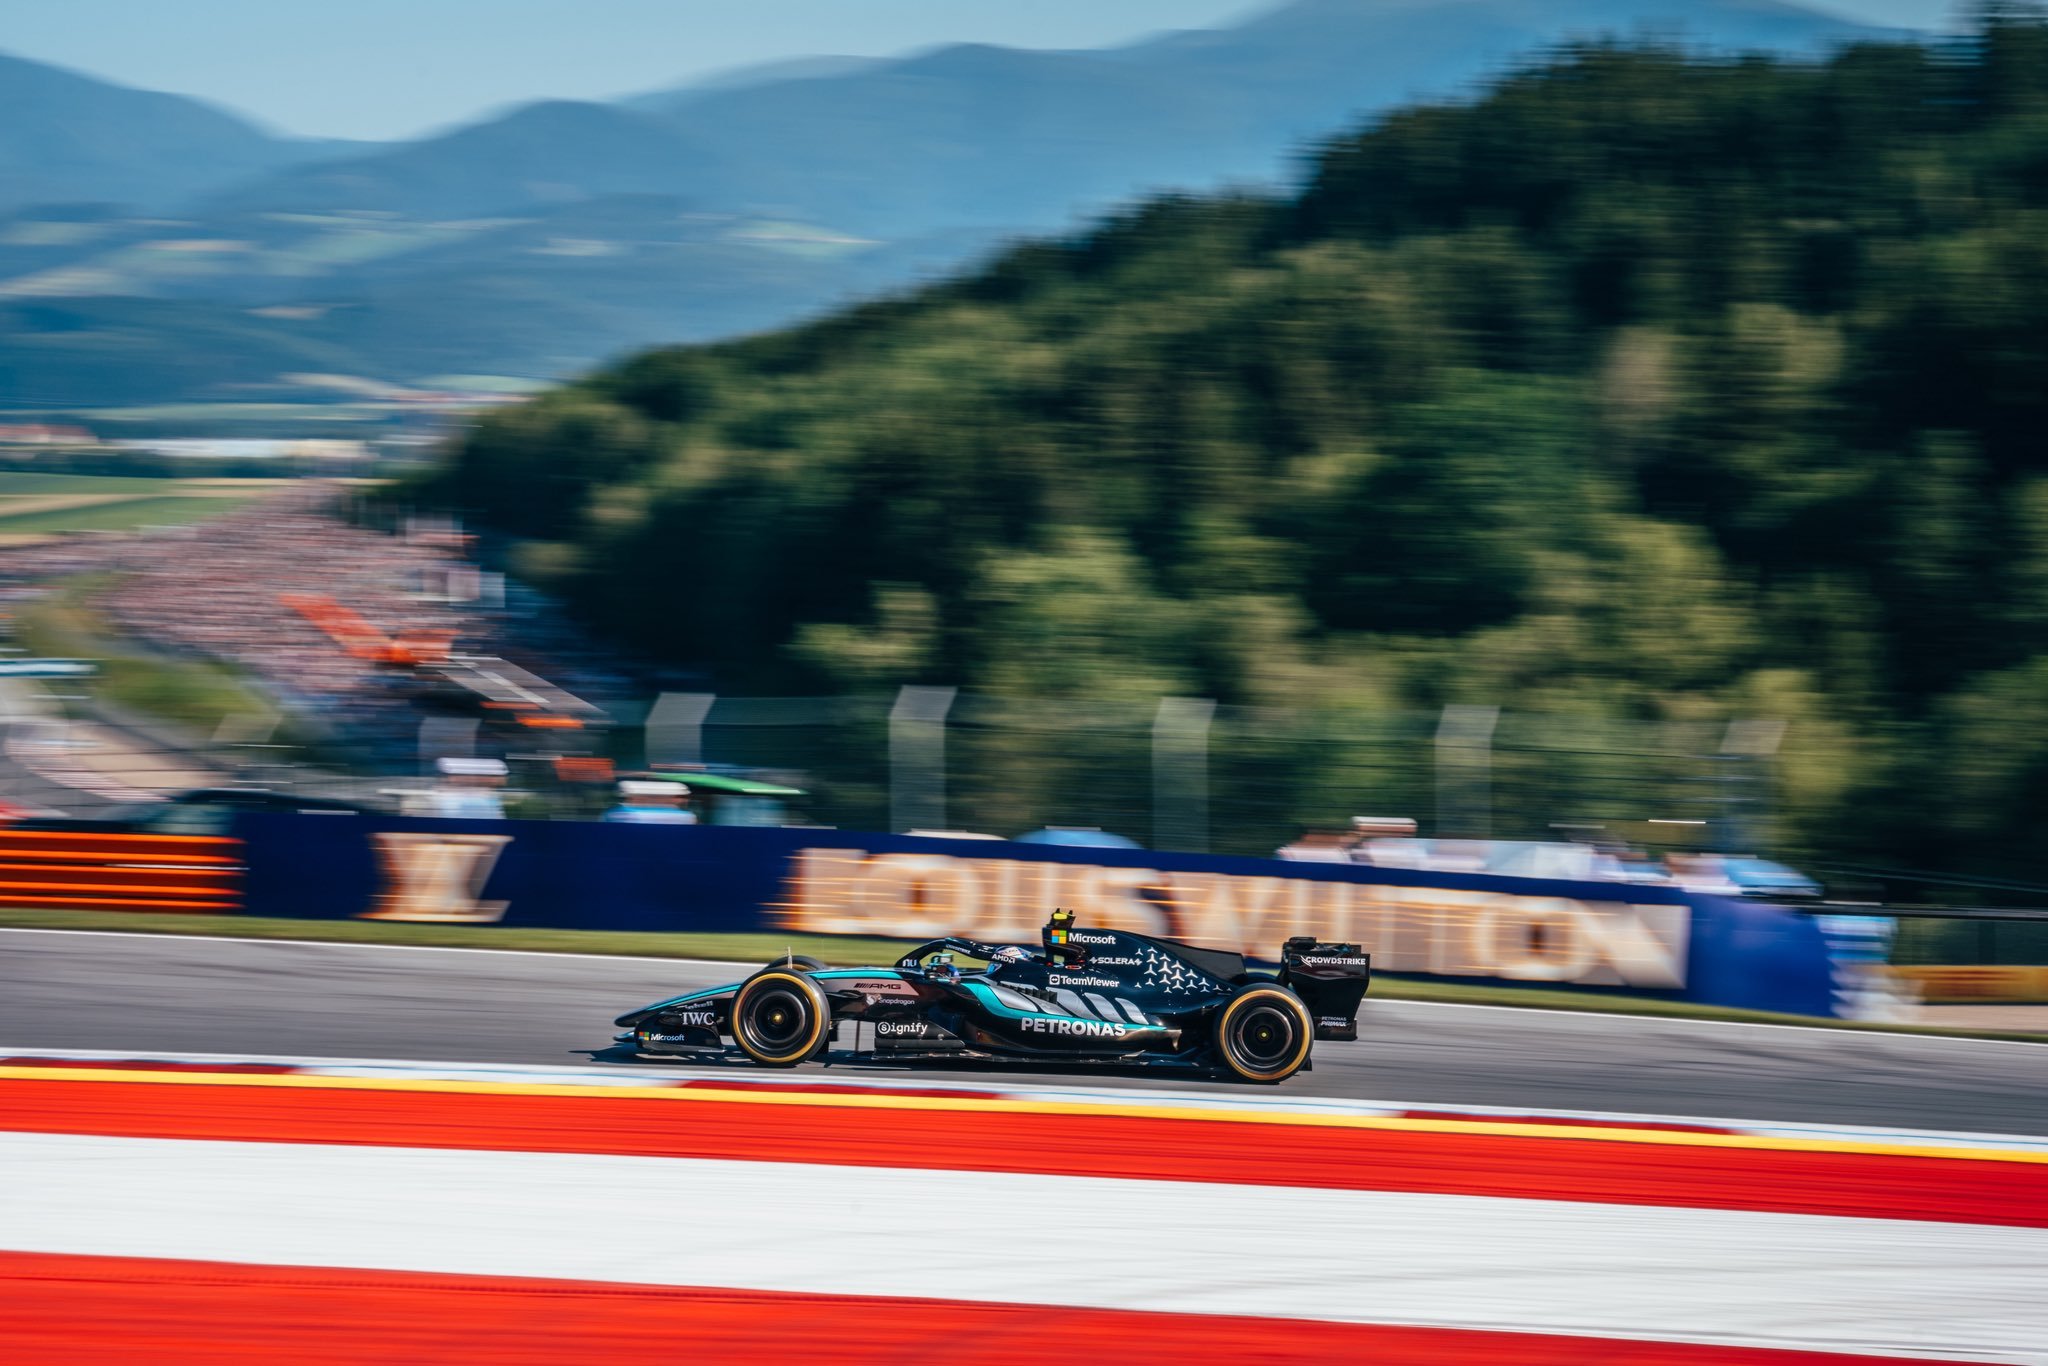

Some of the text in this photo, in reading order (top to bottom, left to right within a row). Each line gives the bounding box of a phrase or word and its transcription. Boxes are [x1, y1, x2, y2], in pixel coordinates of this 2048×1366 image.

[1068, 932, 1116, 945] Microsoft
[991, 953, 1010, 963] AMD
[1096, 957, 1136, 966] SOLERA
[1305, 956, 1366, 966] CROWDSTRIKE
[1060, 975, 1120, 988] TeamViewer
[682, 1012, 715, 1026] IWC
[1021, 1017, 1127, 1037] PETRONAS
[650, 1033, 685, 1042] Microsoft
